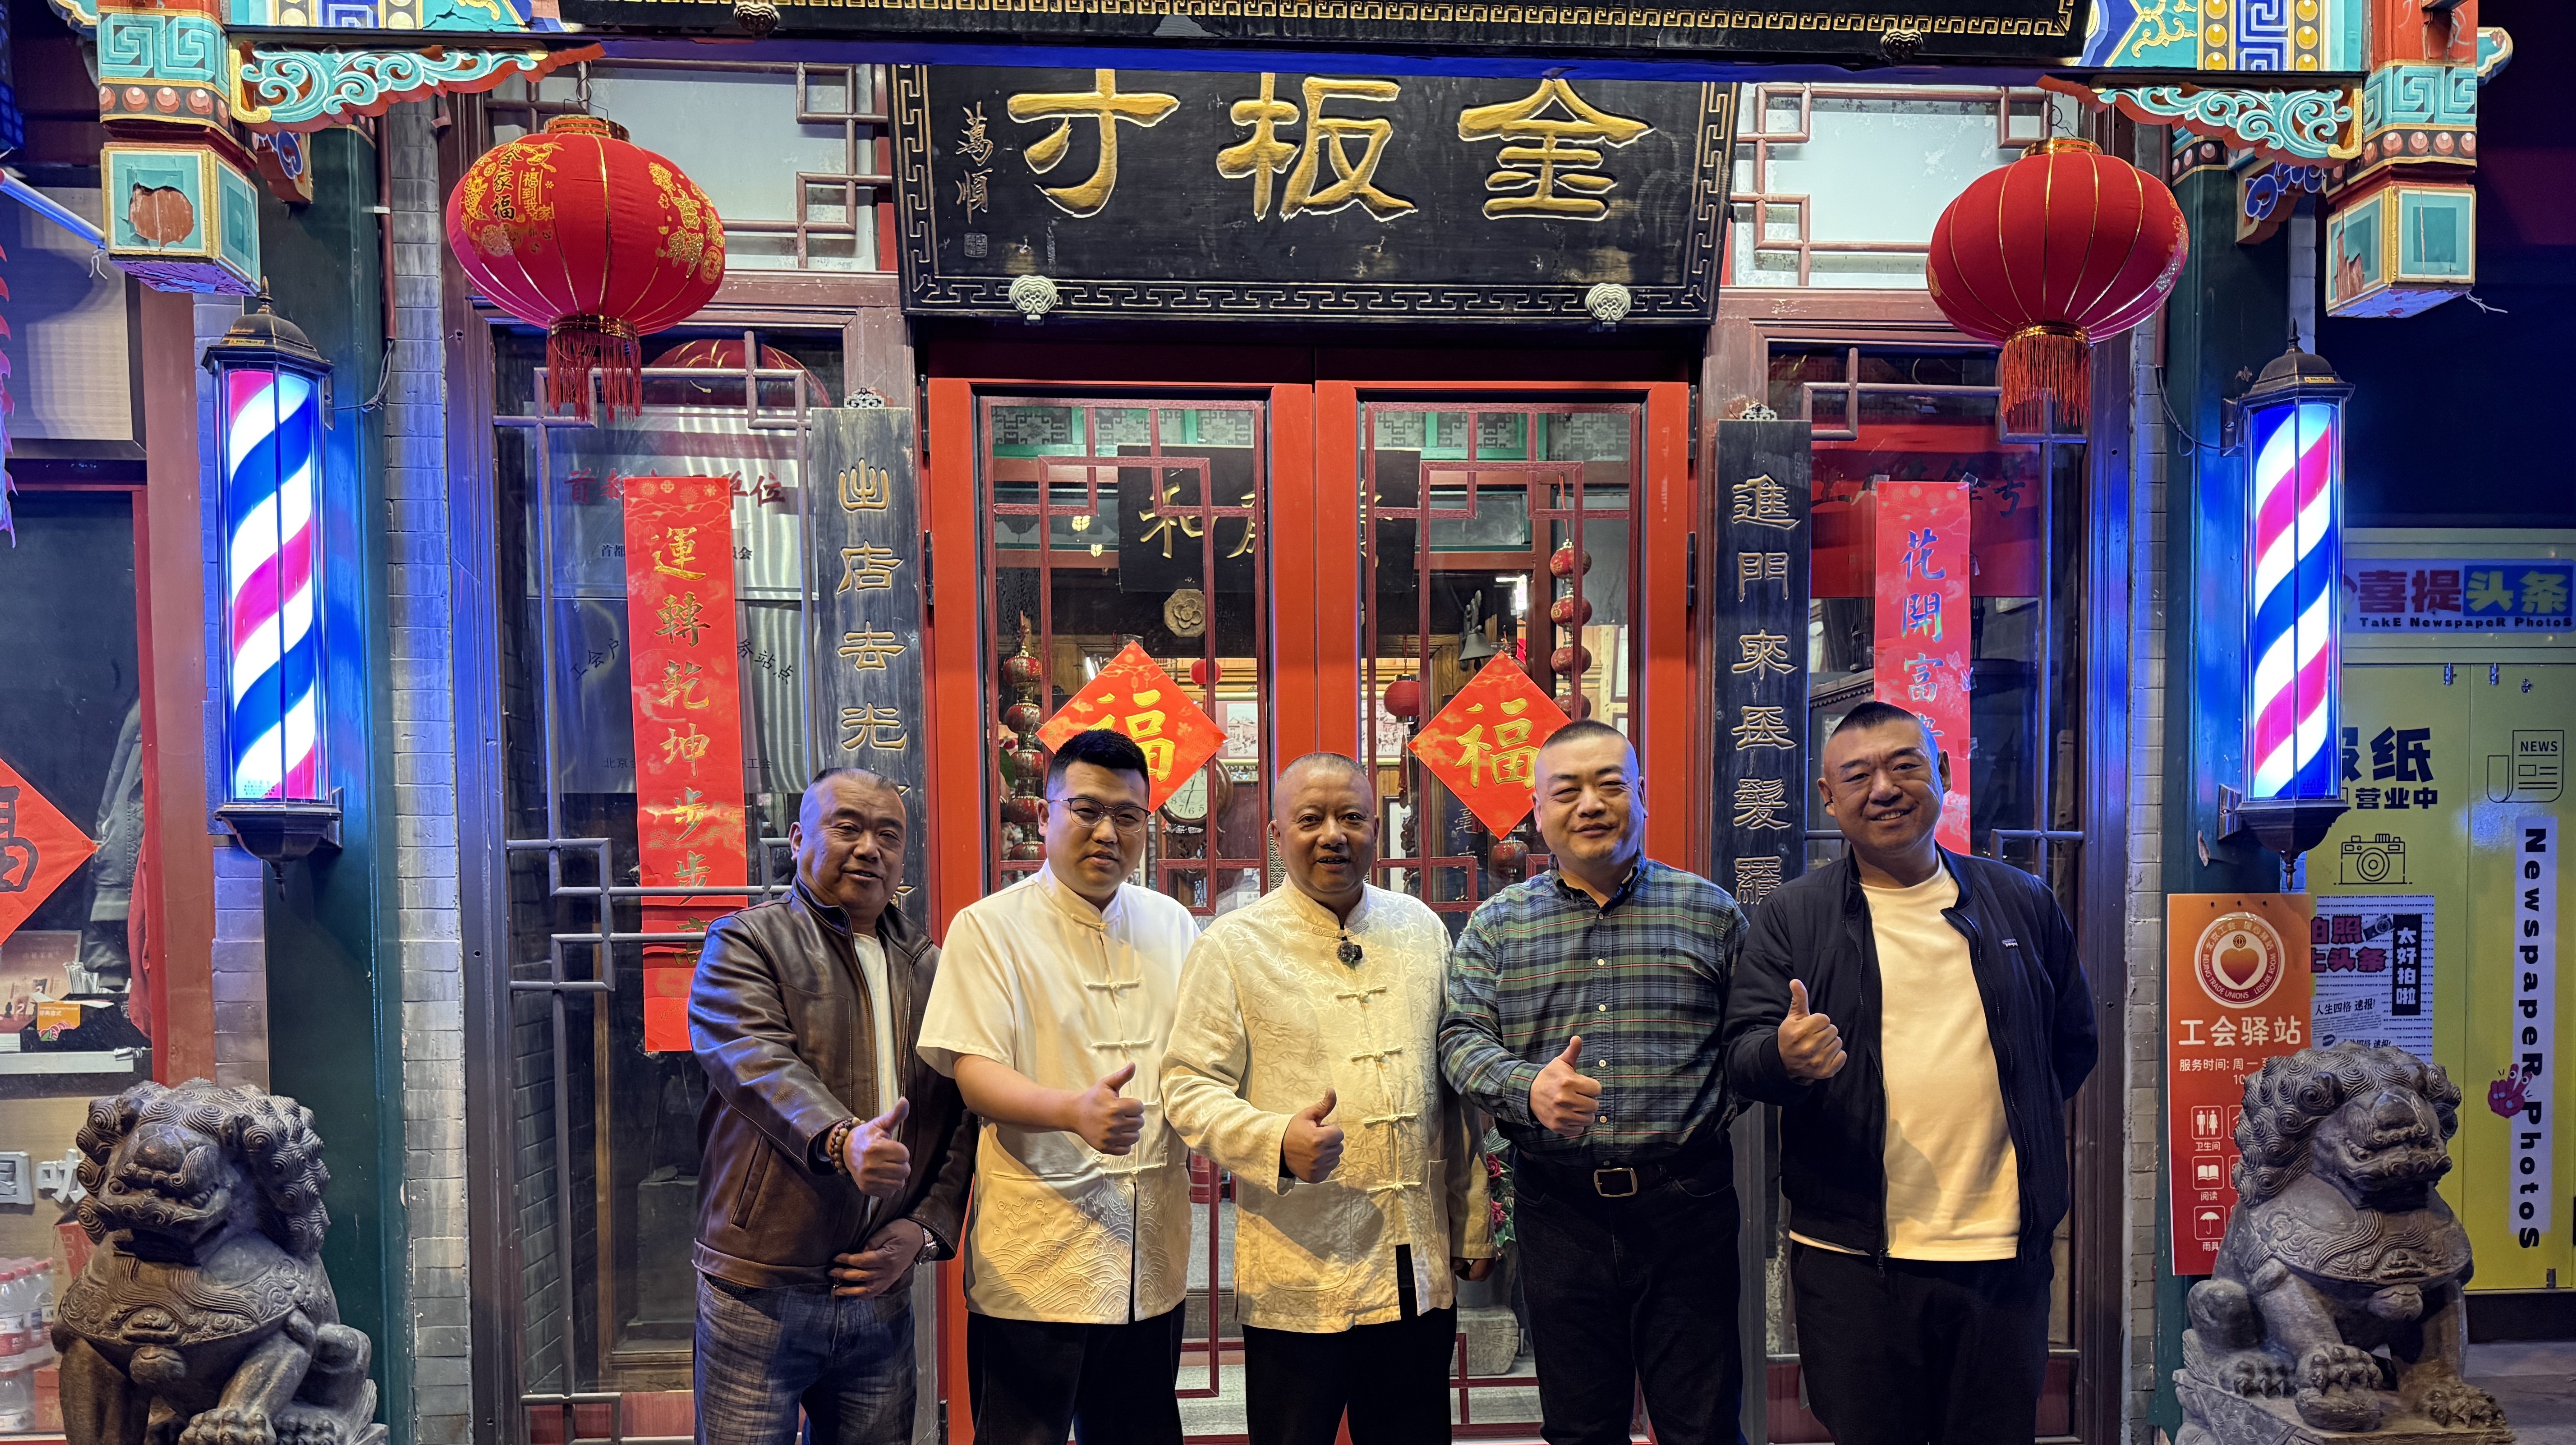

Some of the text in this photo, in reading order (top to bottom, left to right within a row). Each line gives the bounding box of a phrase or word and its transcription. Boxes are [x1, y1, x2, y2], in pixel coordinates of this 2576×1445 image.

[491, 149, 524, 221] 全家福
[2359, 568, 2568, 615] 喜提头条
[1900, 527, 1946, 737] 花開富
[1455, 698, 1541, 789] 福
[2520, 741, 2558, 752] NEWS
[2355, 787, 2438, 809] 营业中
[2396, 927, 2417, 1005] 太好拍啦
[2208, 976, 2226, 994] TRADE
[2225, 991, 2249, 1000] UNIONS
[2254, 973, 2272, 995] LEISURE
[2315, 1001, 2351, 1016] 人生四格
[2179, 1015, 2301, 1047] 工会驿站
[2195, 1141, 2221, 1152] 卫生间
[2201, 1191, 2218, 1201] 阅读
[2202, 1241, 2220, 1252] 雨具
